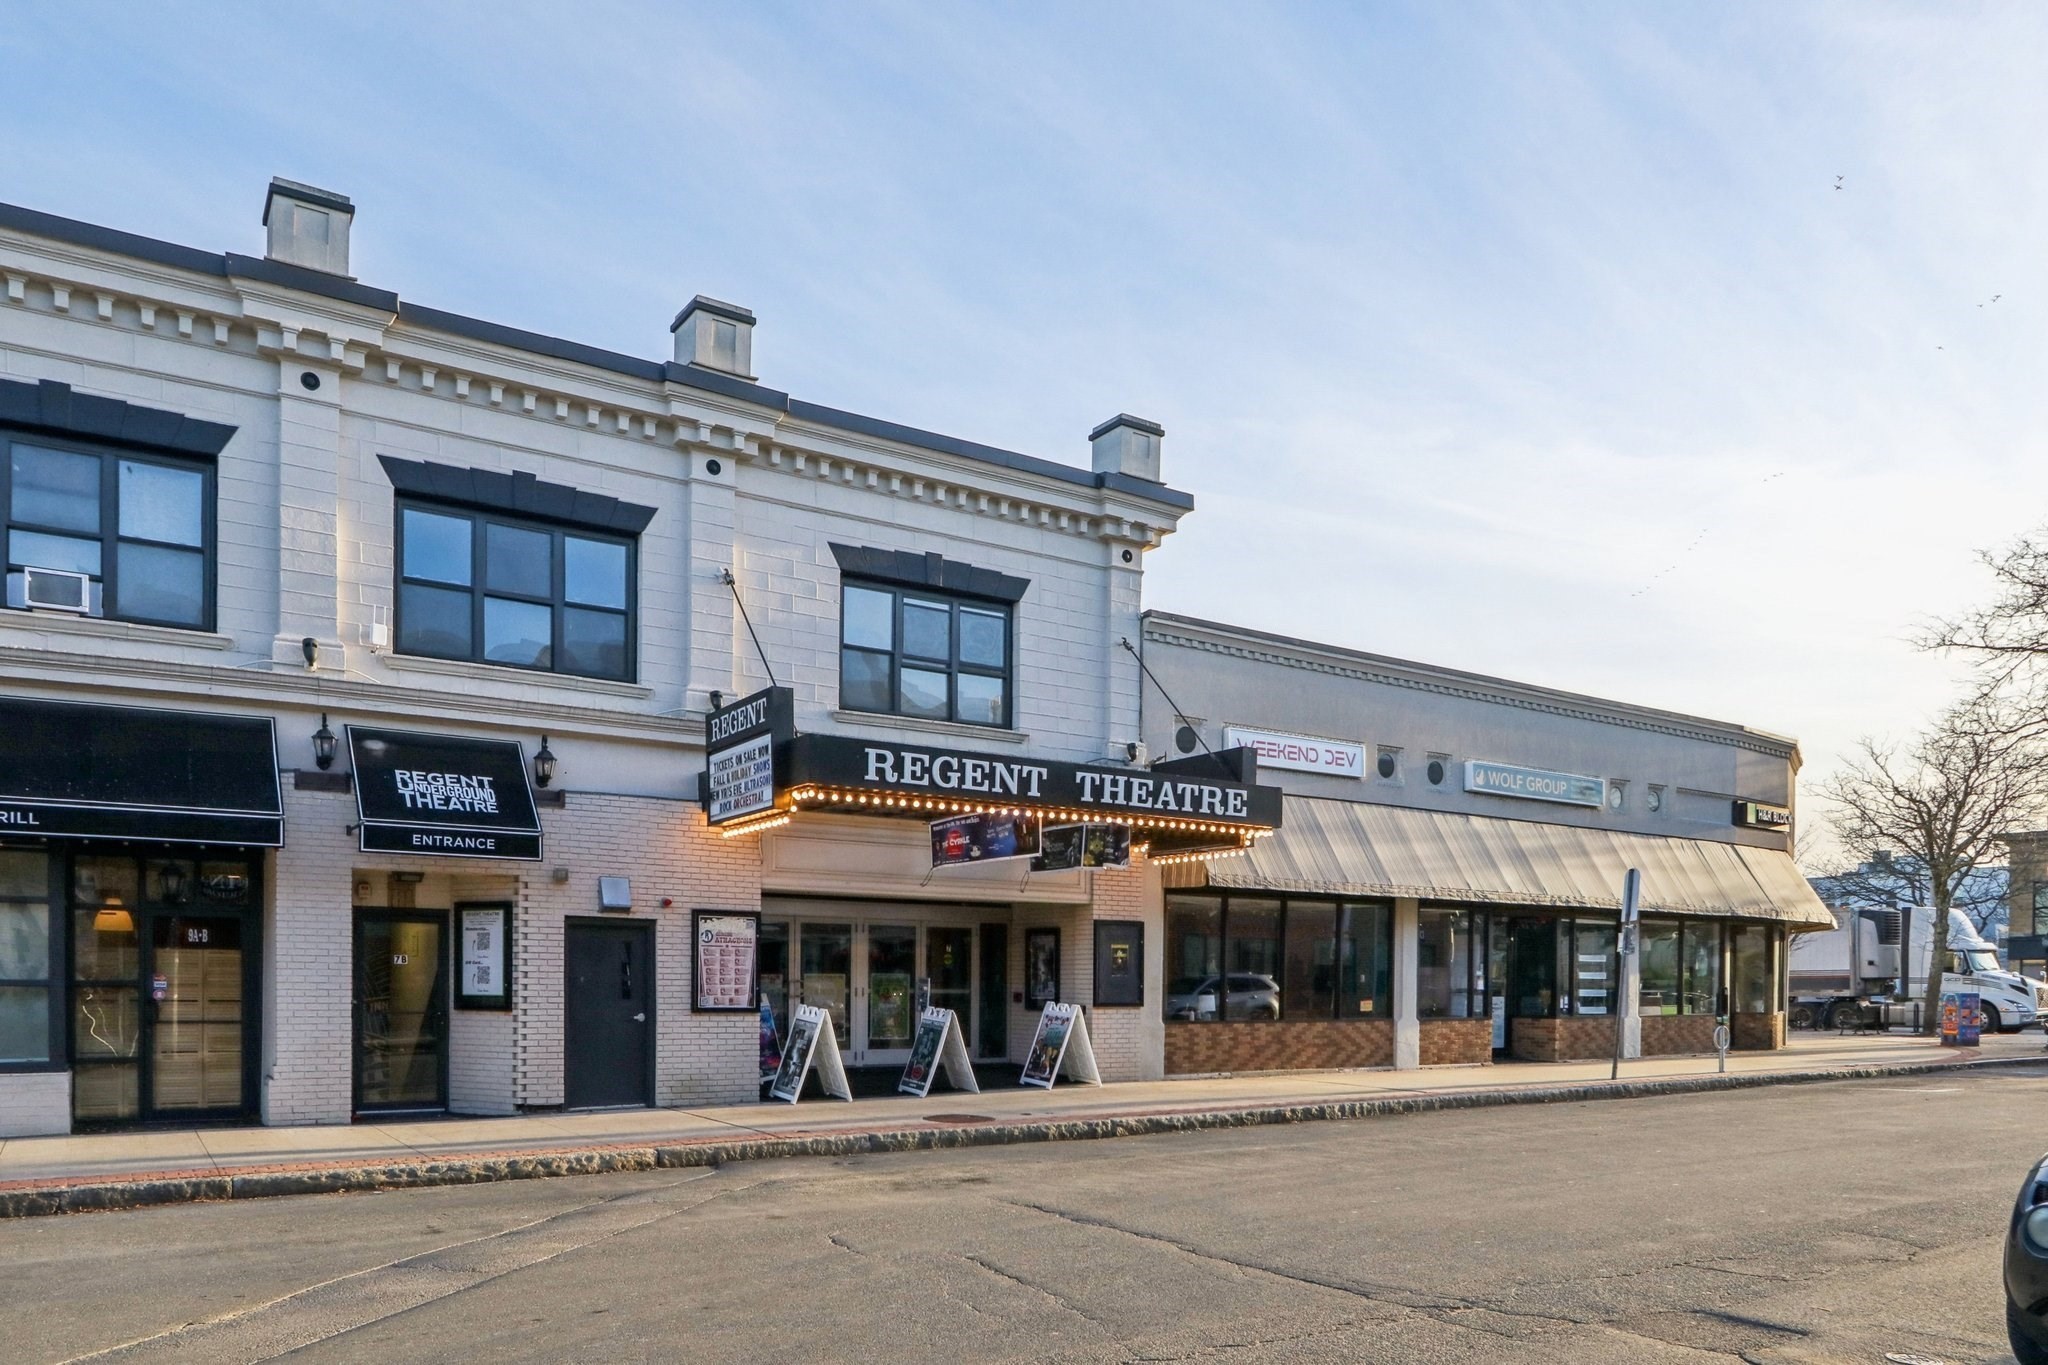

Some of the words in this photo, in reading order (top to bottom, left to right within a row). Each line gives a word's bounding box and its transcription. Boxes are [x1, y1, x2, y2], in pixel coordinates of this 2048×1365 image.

[711, 697, 767, 742] REGENT
[713, 758, 734, 774] TICKETS
[735, 755, 743, 766] ON
[743, 750, 757, 764] SALE
[758, 743, 770, 758] NOW
[1325, 749, 1357, 768] DEV
[394, 769, 493, 789] REGENT
[713, 775, 725, 788] FALL
[731, 765, 752, 782] HOLIDAY
[753, 759, 770, 775] SHOWS
[864, 748, 1047, 797] REGENT
[1075, 771, 1248, 817] THEATRE
[1487, 770, 1523, 789] WOLF
[1526, 776, 1567, 794] GROUP
[397, 779, 497, 803] UNDERGROUND
[733, 783, 742, 795] EVE
[398, 789, 499, 814] THEATRE
[719, 800, 732, 813] ROCK
[412, 834, 496, 849] ENTRANCE
